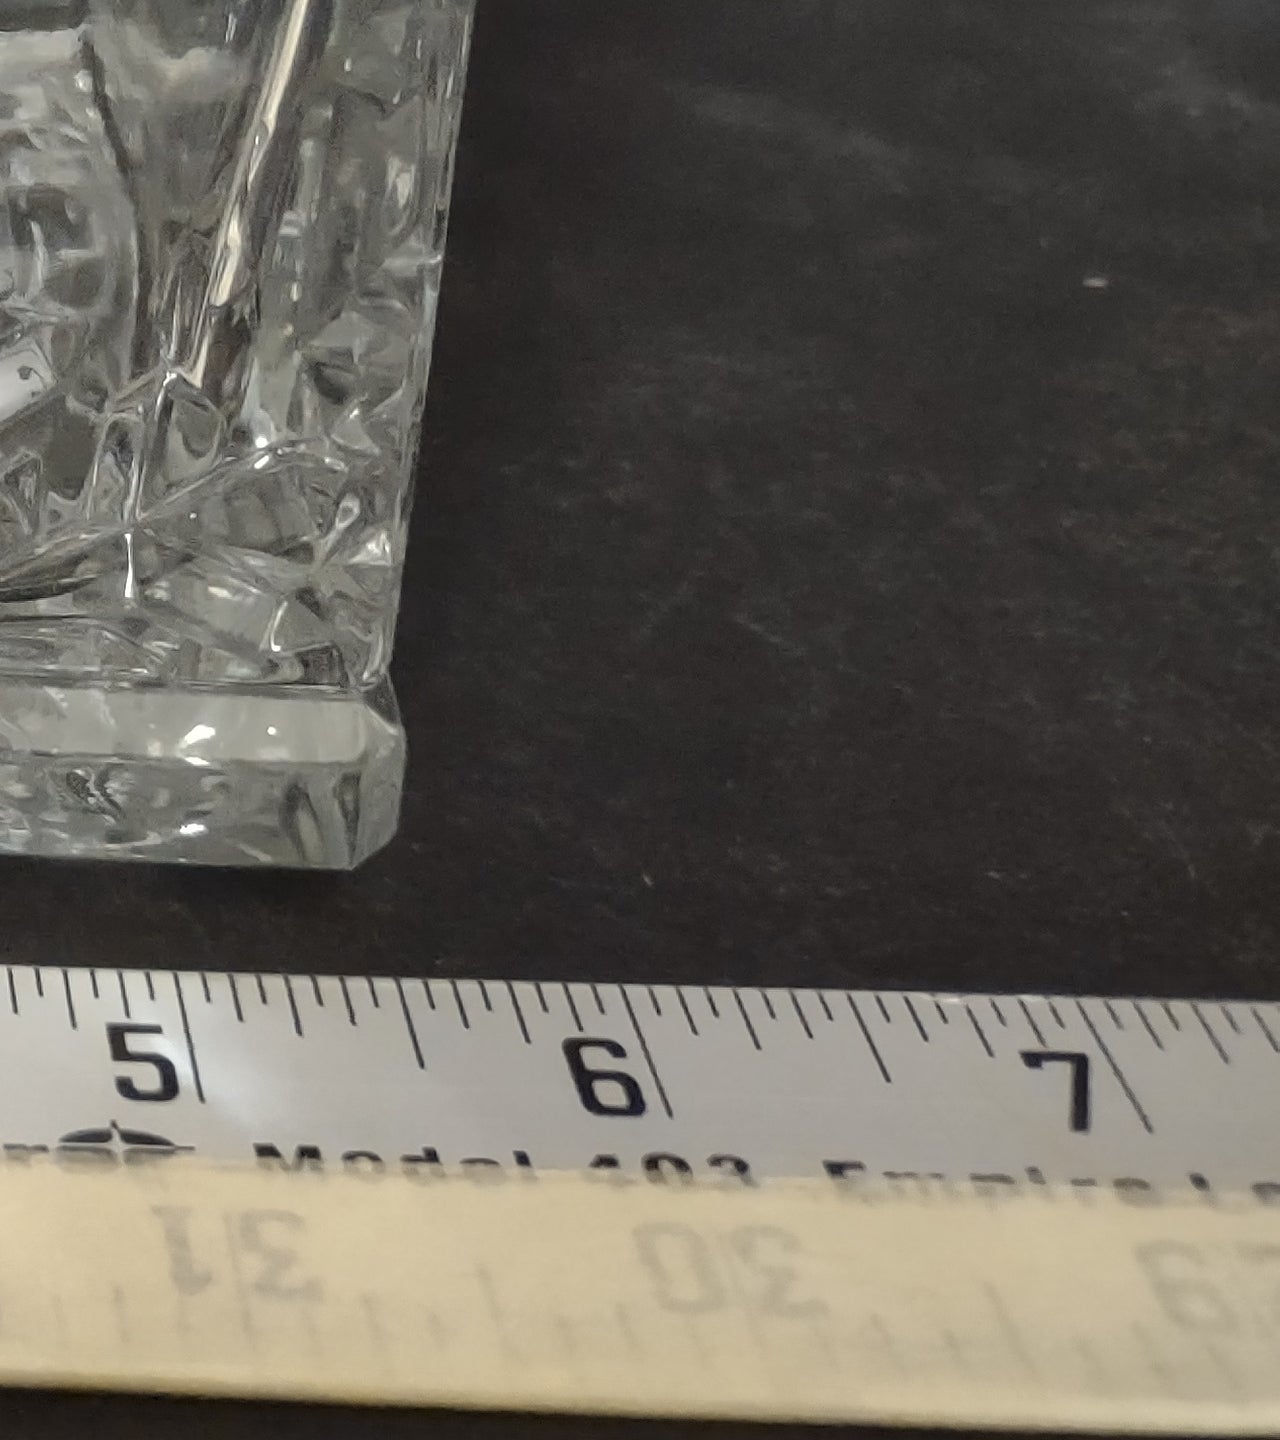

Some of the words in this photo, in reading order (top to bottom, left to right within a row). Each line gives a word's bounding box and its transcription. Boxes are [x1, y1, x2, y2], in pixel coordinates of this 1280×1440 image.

[105, 1022, 181, 1102] 5
[561, 1037, 646, 1117] 6
[1018, 1049, 1090, 1132] 7
